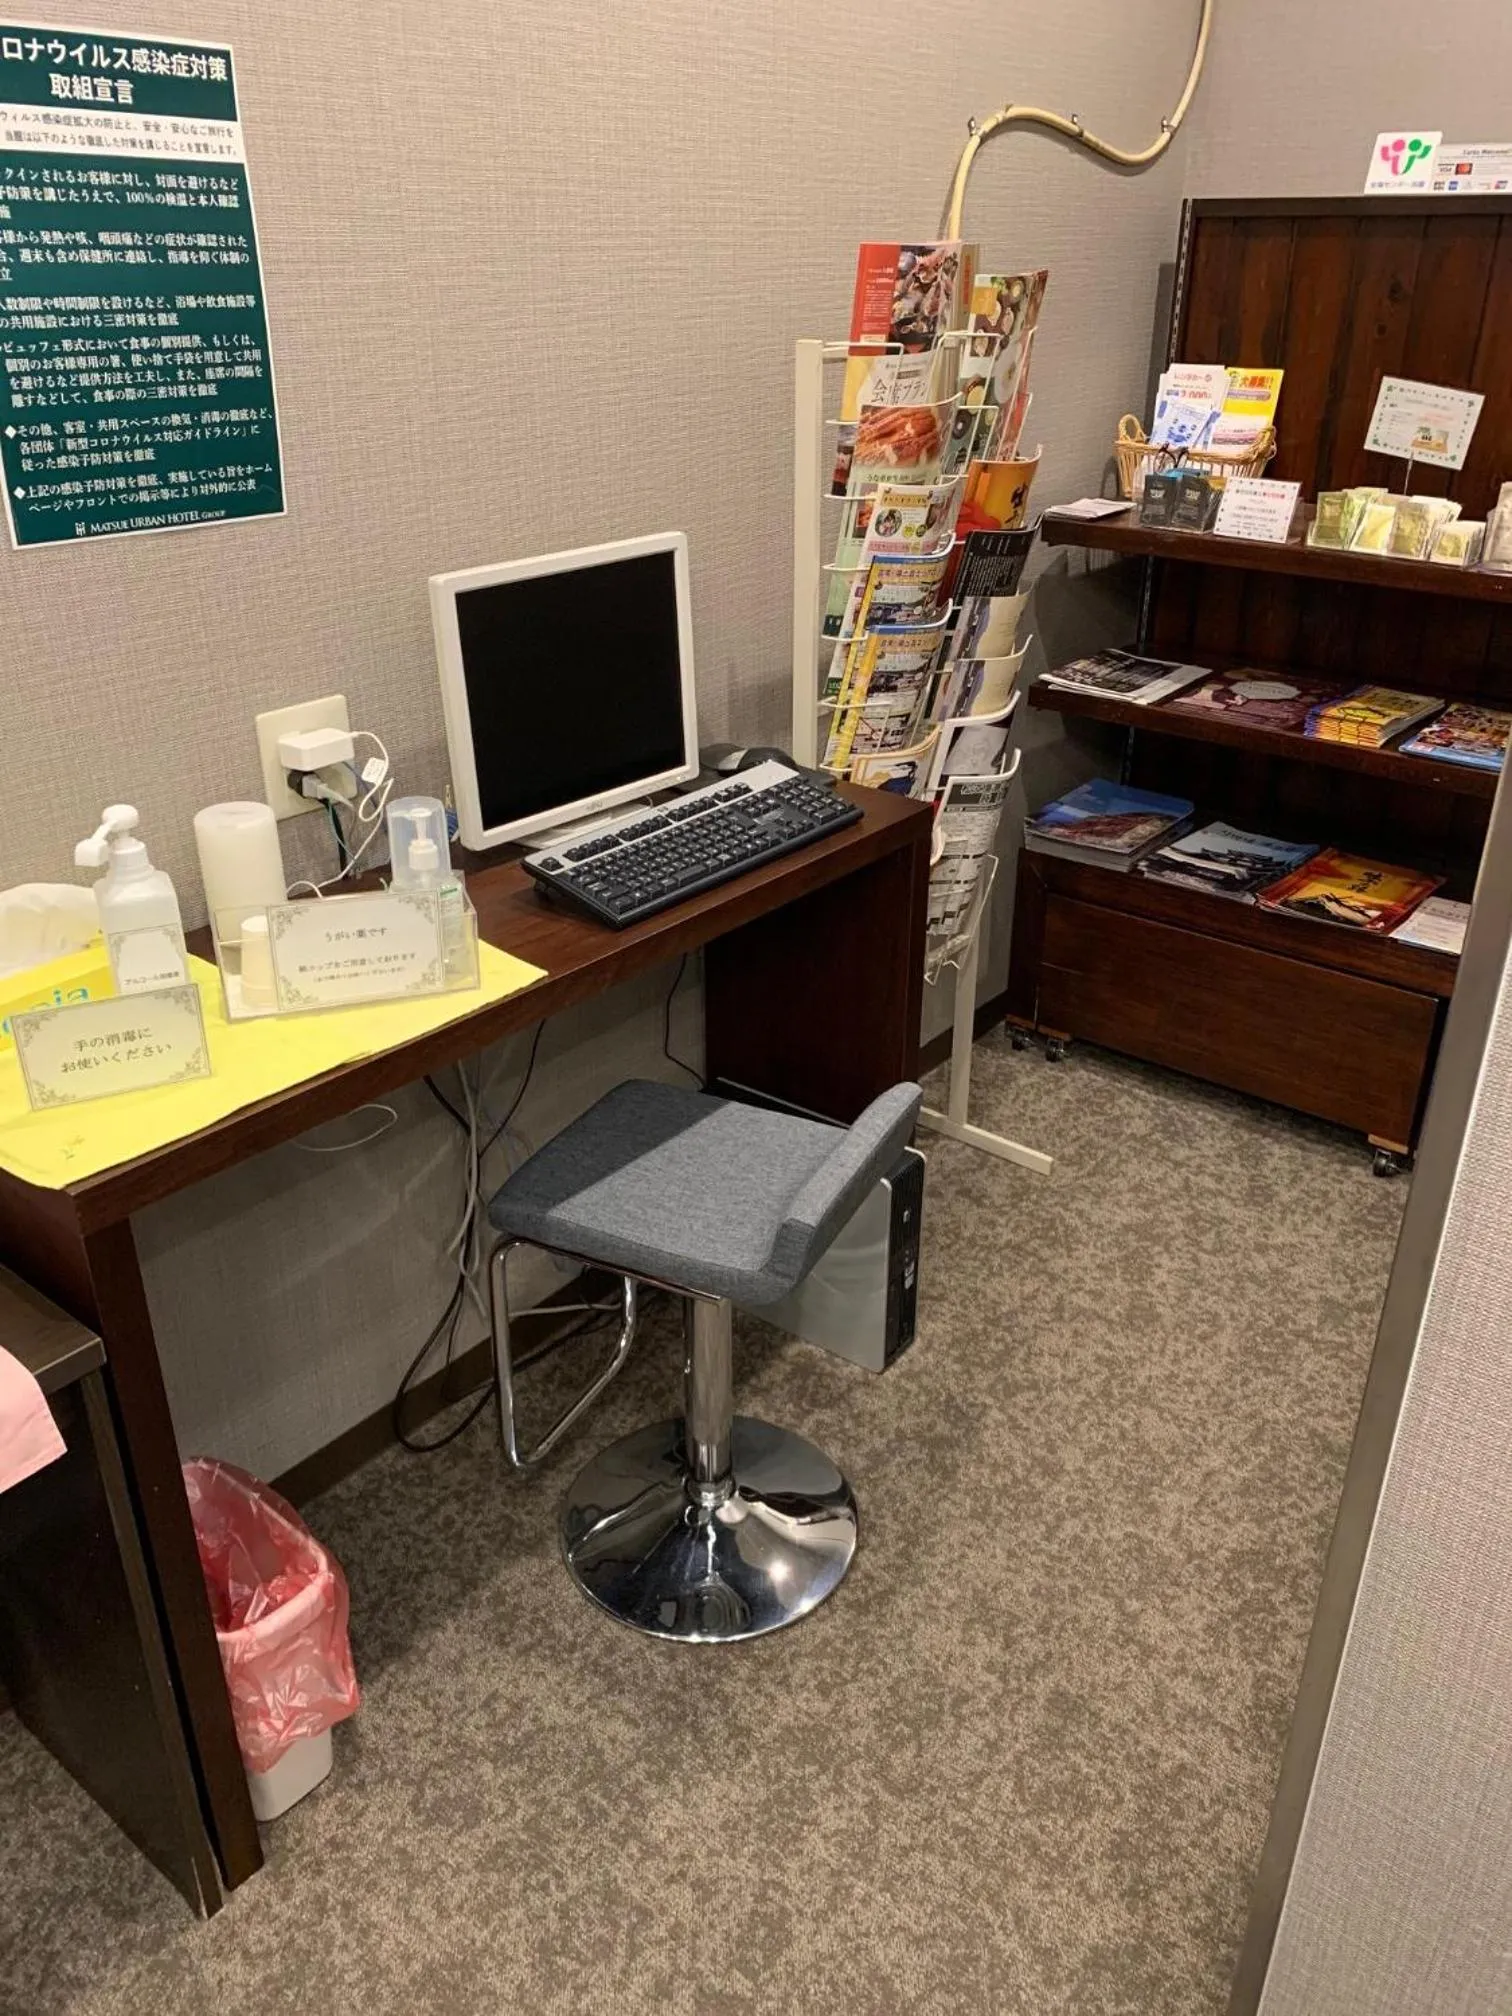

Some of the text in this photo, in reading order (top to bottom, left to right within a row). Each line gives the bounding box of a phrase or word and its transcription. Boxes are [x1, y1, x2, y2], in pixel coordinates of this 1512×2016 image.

[1, 36, 229, 82] ロナウイルス感染症対策
[49, 72, 135, 104] 取組宣言
[90, 519, 129, 534] MATSUE
[130, 514, 166, 529] URBAN
[167, 510, 201, 525] HOTEL
[325, 926, 389, 943] うがい薬です
[72, 1026, 153, 1053] 手の消毒に
[61, 1043, 172, 1074] お使いください
